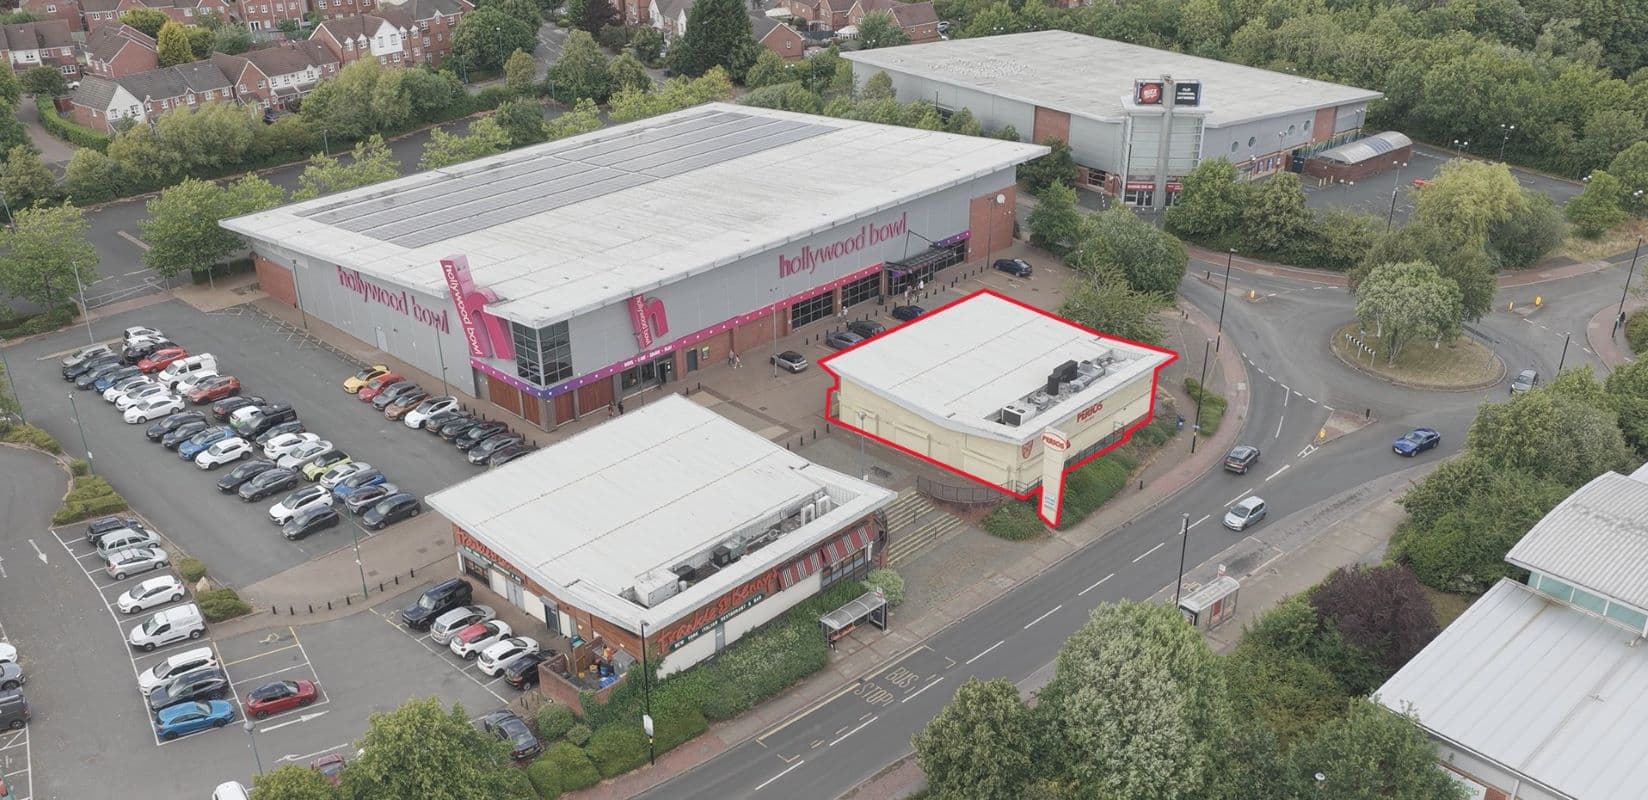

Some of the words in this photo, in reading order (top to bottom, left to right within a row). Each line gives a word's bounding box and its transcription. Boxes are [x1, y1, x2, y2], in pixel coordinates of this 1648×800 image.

[779, 226, 865, 278] hollywood
[870, 211, 906, 246] bowl
[337, 265, 408, 316] hollywood
[411, 296, 450, 335] bowl
[445, 264, 472, 325] hollywood
[467, 327, 483, 355] bowl
[656, 606, 718, 655] Frankie
[854, 682, 894, 705] STOP
[884, 666, 920, 688] BUS
